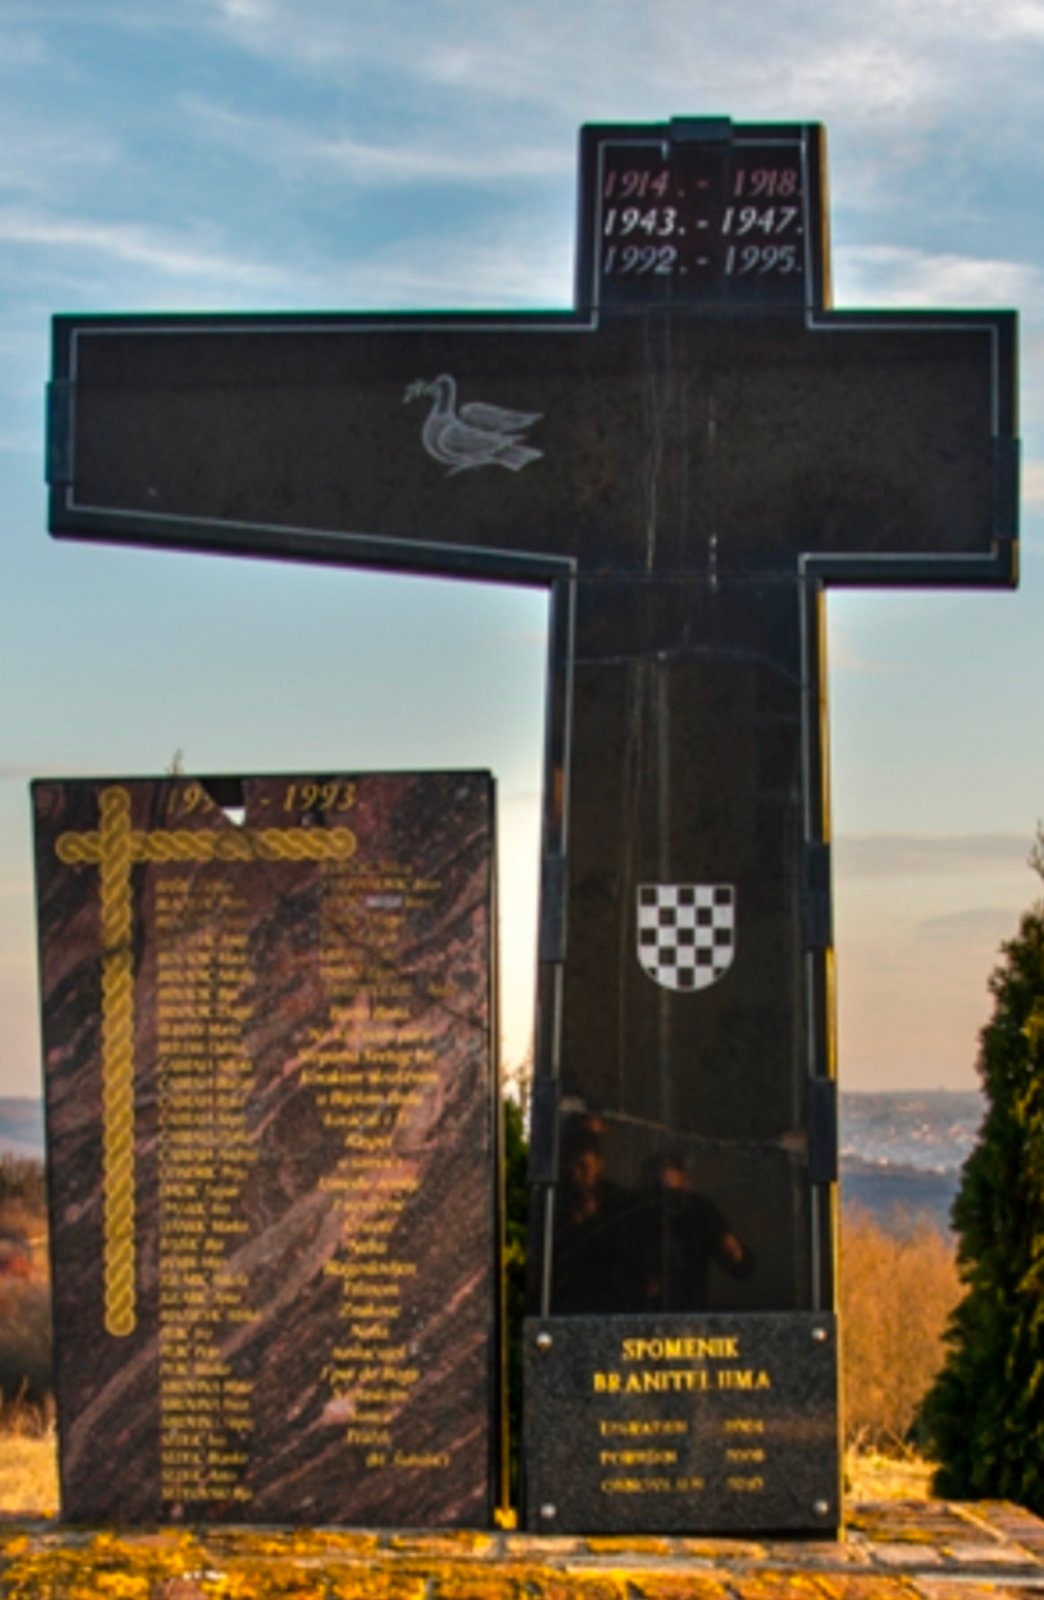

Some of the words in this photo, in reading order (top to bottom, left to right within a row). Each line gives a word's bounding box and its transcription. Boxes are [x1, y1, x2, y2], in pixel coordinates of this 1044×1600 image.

[603, 169, 685, 198] 1914.
[603, 206, 686, 236] 1943.
[722, 205, 804, 236] 1947.
[603, 245, 687, 275] 1992.
[725, 244, 804, 275] 1995.
[621, 1335, 740, 1361] SPOMENIK
